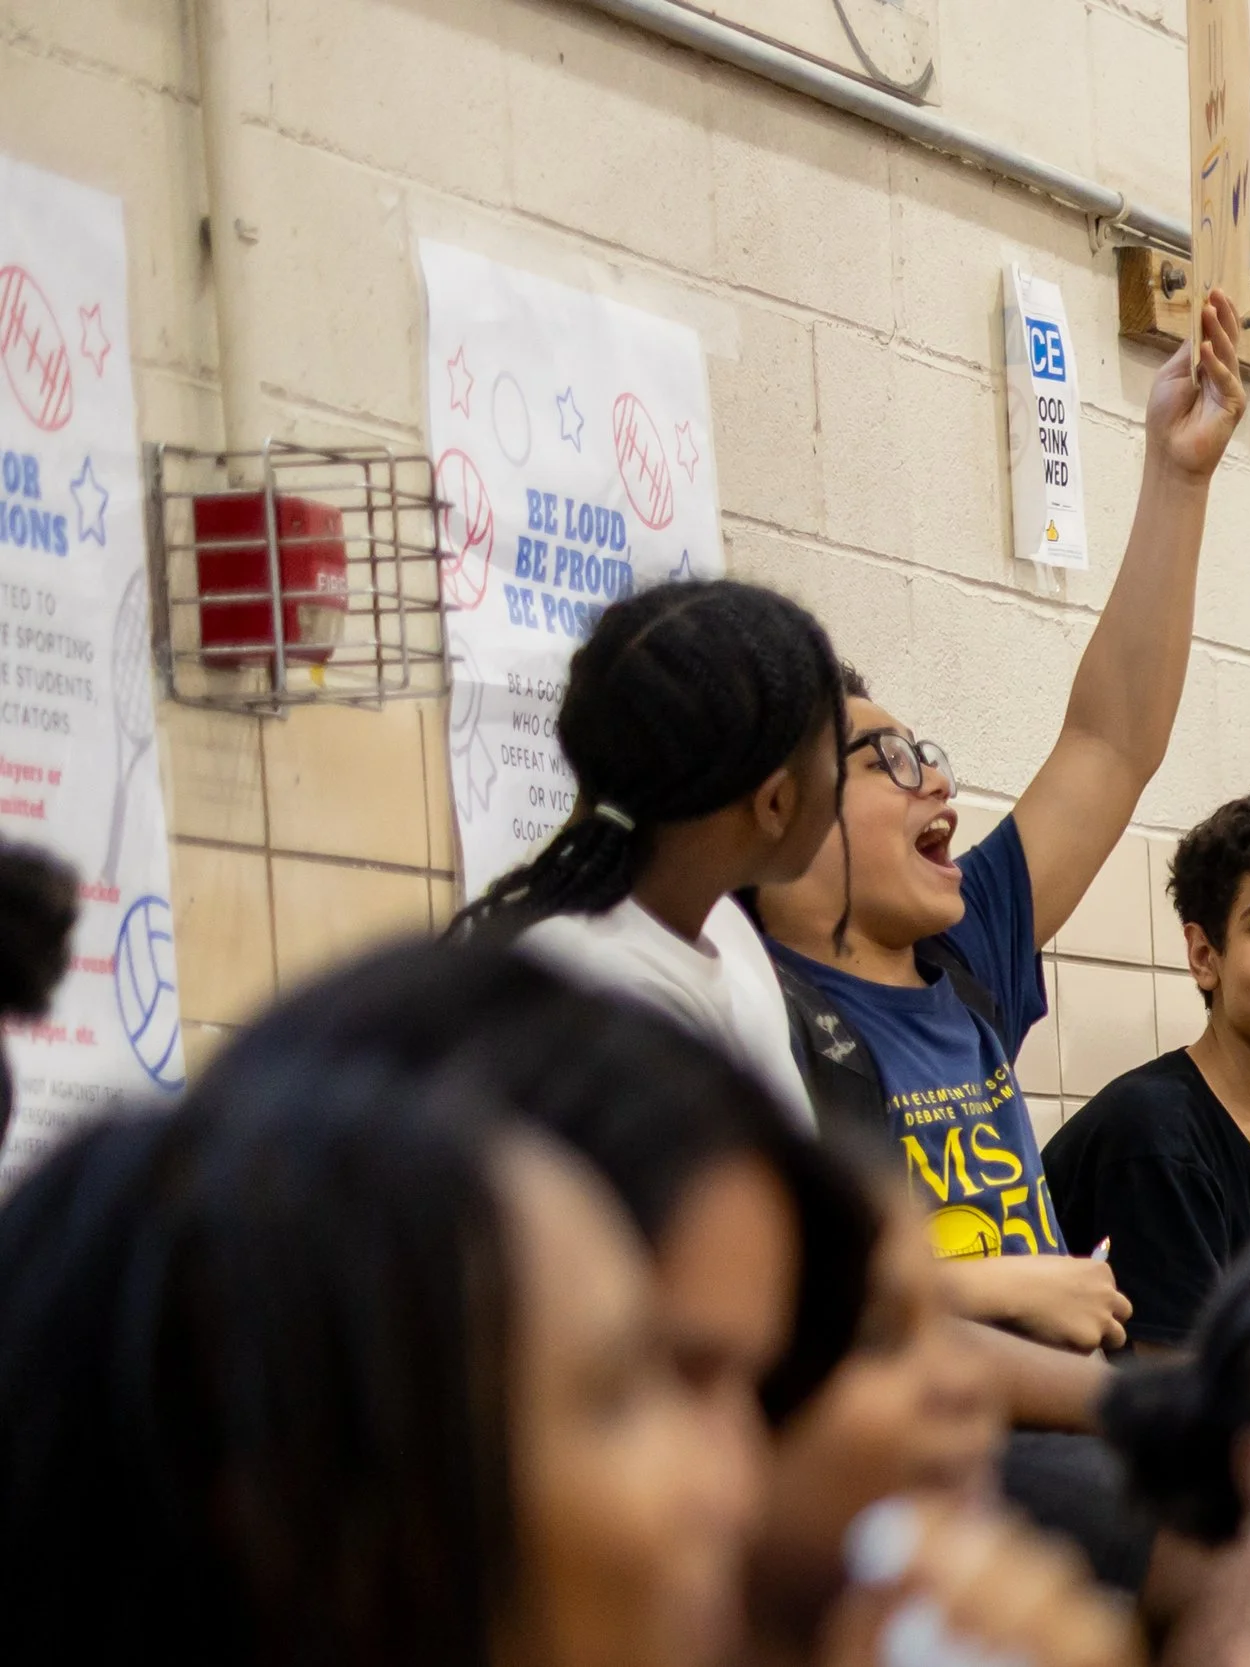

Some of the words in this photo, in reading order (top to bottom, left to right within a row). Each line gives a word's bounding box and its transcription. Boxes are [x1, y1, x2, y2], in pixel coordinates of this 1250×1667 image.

[1037, 396, 1065, 424] OOD
[1039, 427, 1069, 456] RINK
[2, 451, 41, 500] OR
[526, 488, 558, 535] BE
[0, 501, 69, 557] IONS
[514, 535, 549, 583] BE
[1, 583, 31, 612] TED
[36, 589, 56, 617] TO
[503, 583, 539, 629] BE
[16, 625, 94, 664] SPORTING
[507, 672, 522, 696] BE
[525, 676, 534, 699] A
[537, 679, 566, 704] GOO
[3, 701, 71, 735] CTATORS
[512, 710, 540, 736] WHO
[543, 717, 561, 739] CA
[0, 754, 43, 784] layers
[501, 743, 545, 772] DEFEAT
[529, 784, 545, 808] OR
[548, 788, 577, 813] VICT
[513, 818, 555, 842] GLOAT
[904, 1106, 956, 1126] DEBATE
[960, 1085, 1015, 1116] TOURNAM
[901, 1122, 1023, 1202] MS
